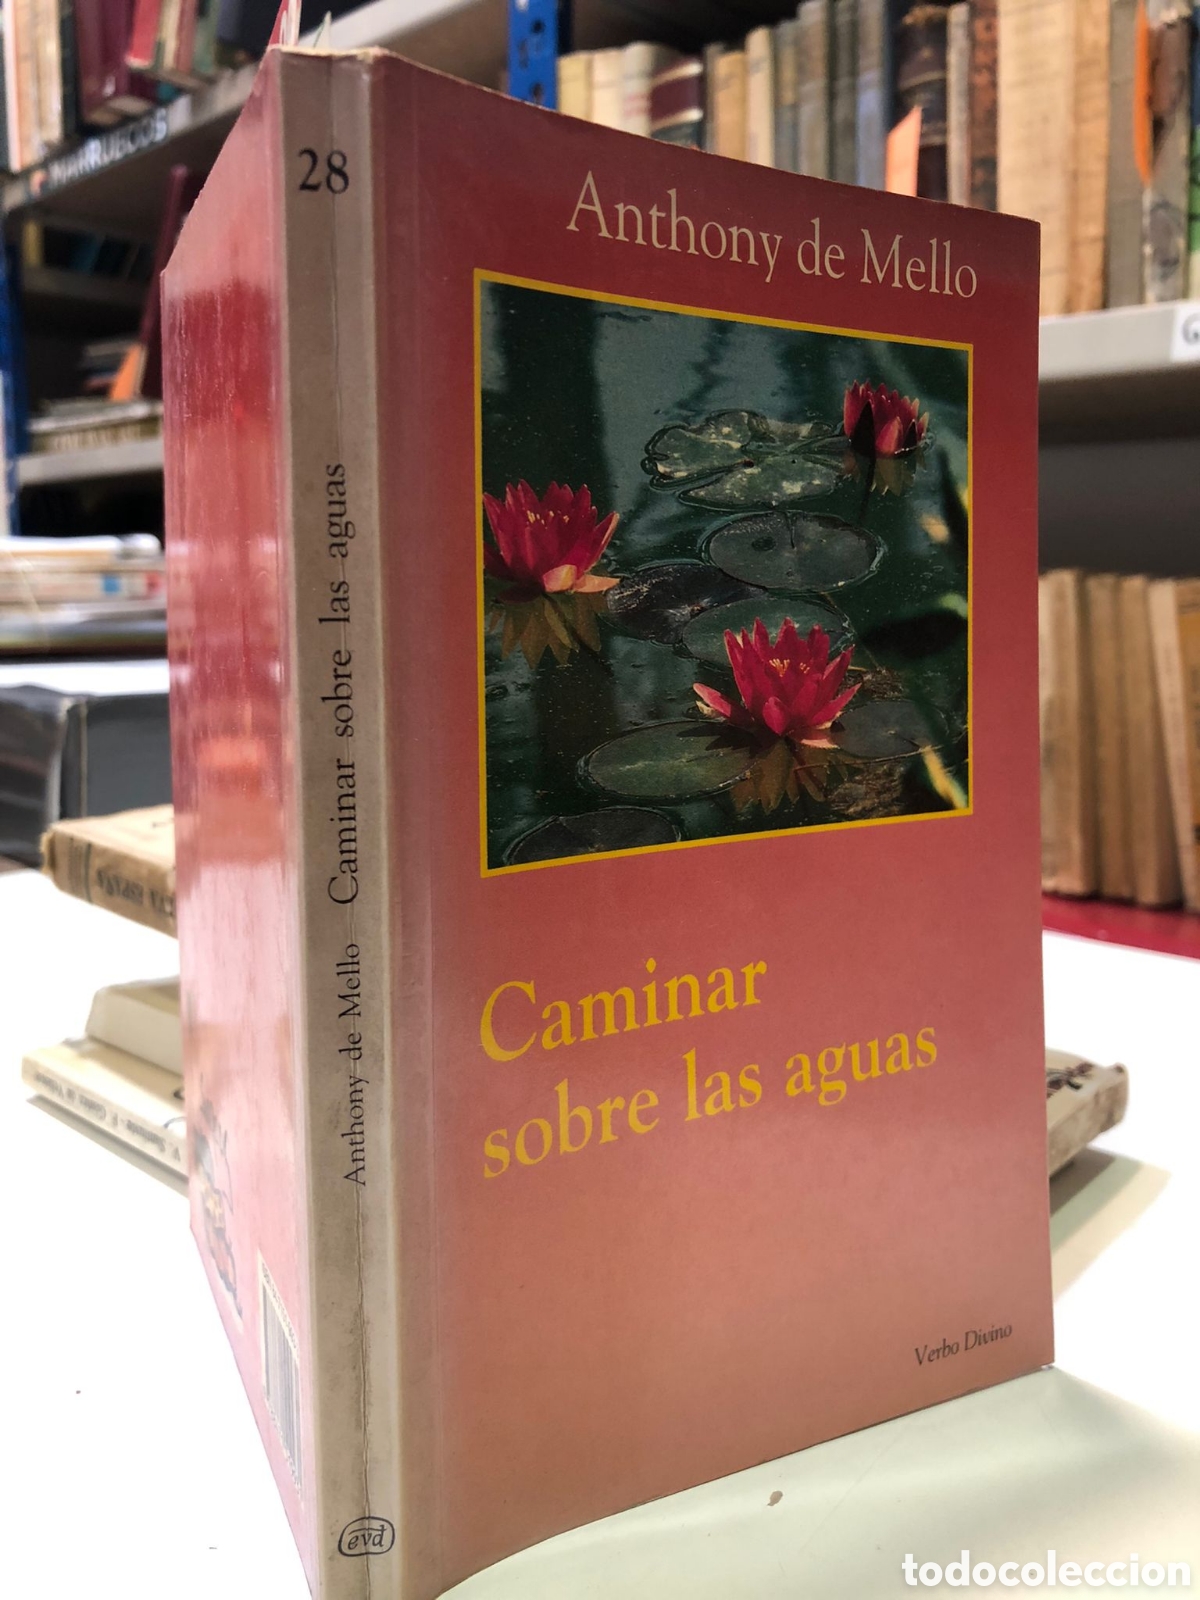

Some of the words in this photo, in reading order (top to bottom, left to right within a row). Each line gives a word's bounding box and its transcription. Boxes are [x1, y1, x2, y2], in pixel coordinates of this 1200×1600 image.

[297, 148, 350, 194] 28
[566, 170, 783, 283] Anthony
[797, 217, 845, 279] de
[860, 228, 978, 298] Mello
[325, 463, 356, 559] aguas
[318, 580, 351, 623] las
[321, 649, 353, 738] sobre
[328, 757, 359, 905] Caminar
[336, 943, 362, 1019] Mello
[479, 957, 768, 1062] Caminar
[338, 1031, 363, 1062] de
[341, 1074, 369, 1186] Anthony
[483, 1078, 659, 1178] sobre
[682, 1047, 763, 1122] las
[785, 1026, 937, 1106] aguas
[915, 1338, 960, 1366] Verbo
[964, 1323, 1013, 1352] Divino
[347, 1523, 387, 1551] evd
